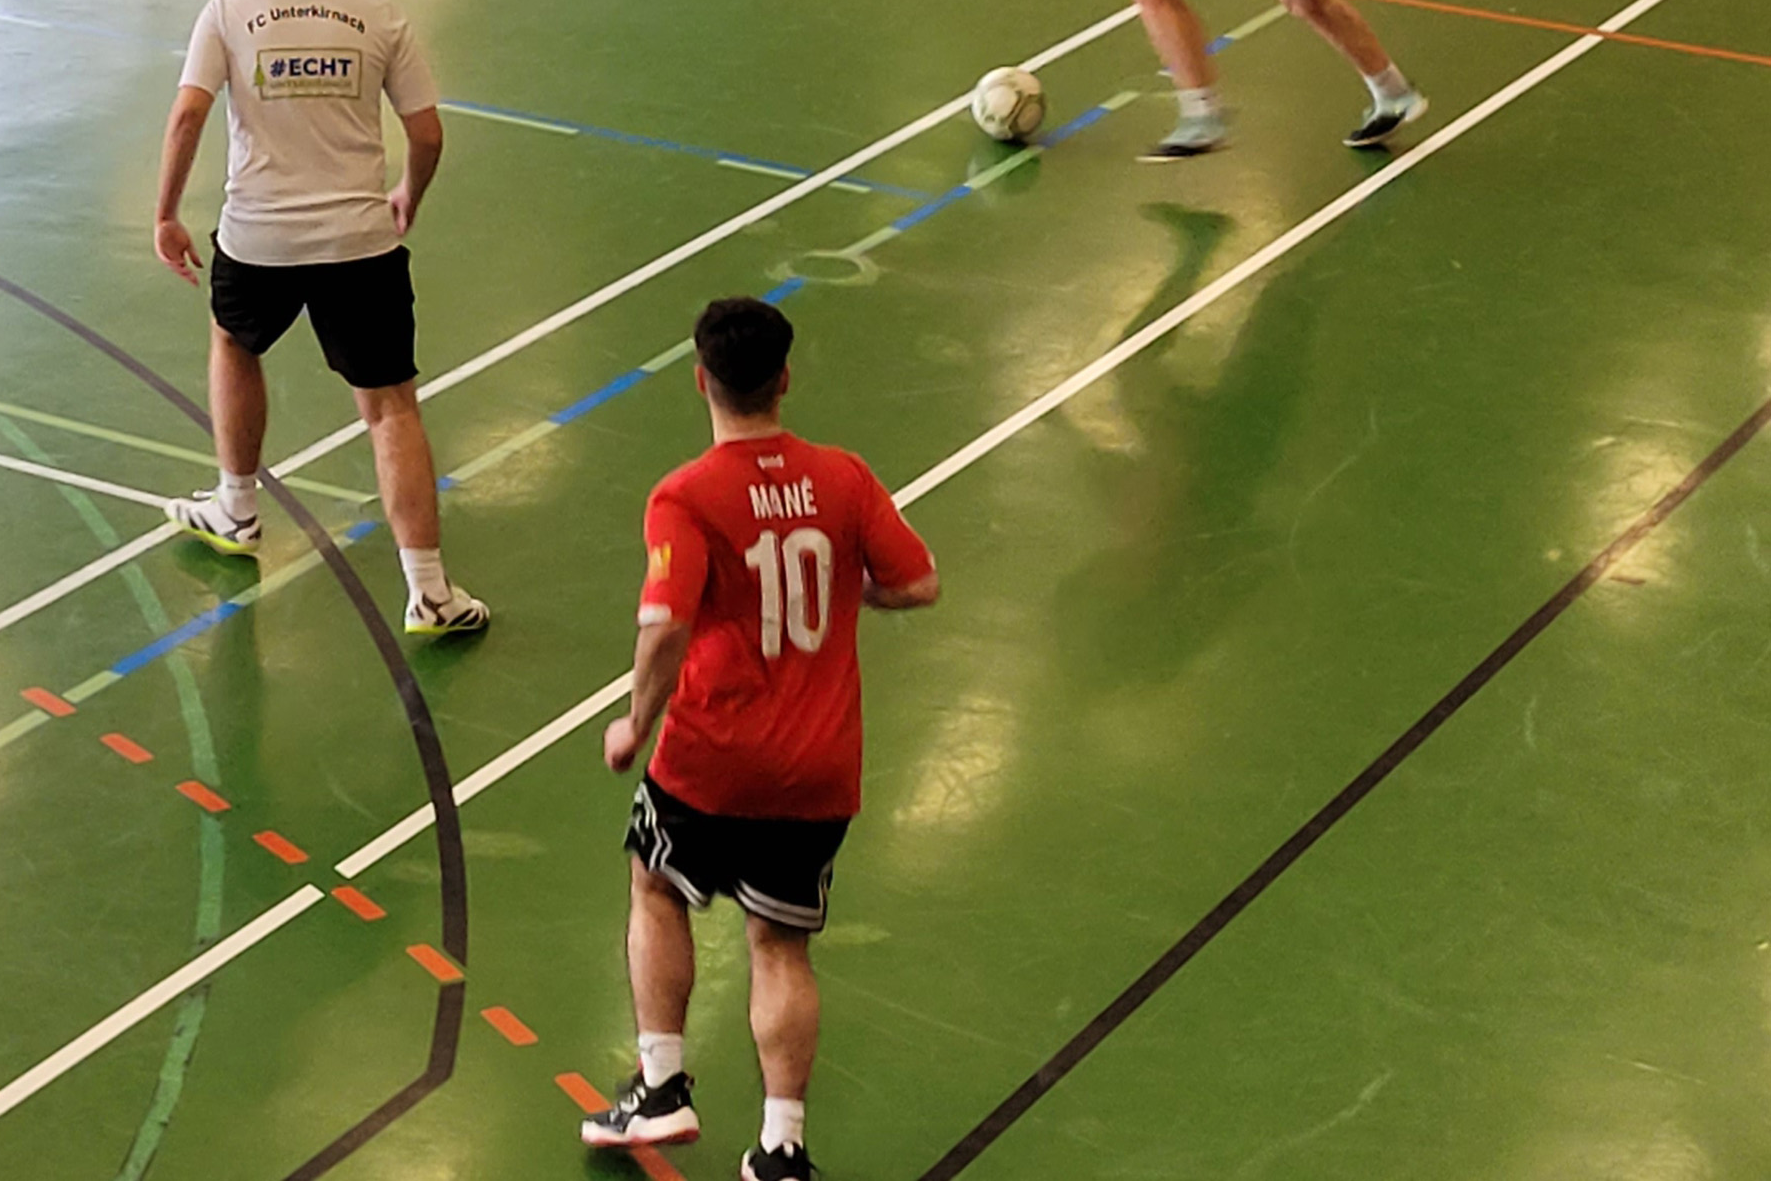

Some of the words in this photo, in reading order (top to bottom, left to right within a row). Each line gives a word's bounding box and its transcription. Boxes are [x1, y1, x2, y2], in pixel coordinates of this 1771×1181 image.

[247, 14, 267, 34] FC
[270, 5, 366, 34] Unterkirnach
[270, 58, 353, 77] #ECHT
[748, 475, 818, 519] MANÉ
[745, 528, 832, 658] 10
